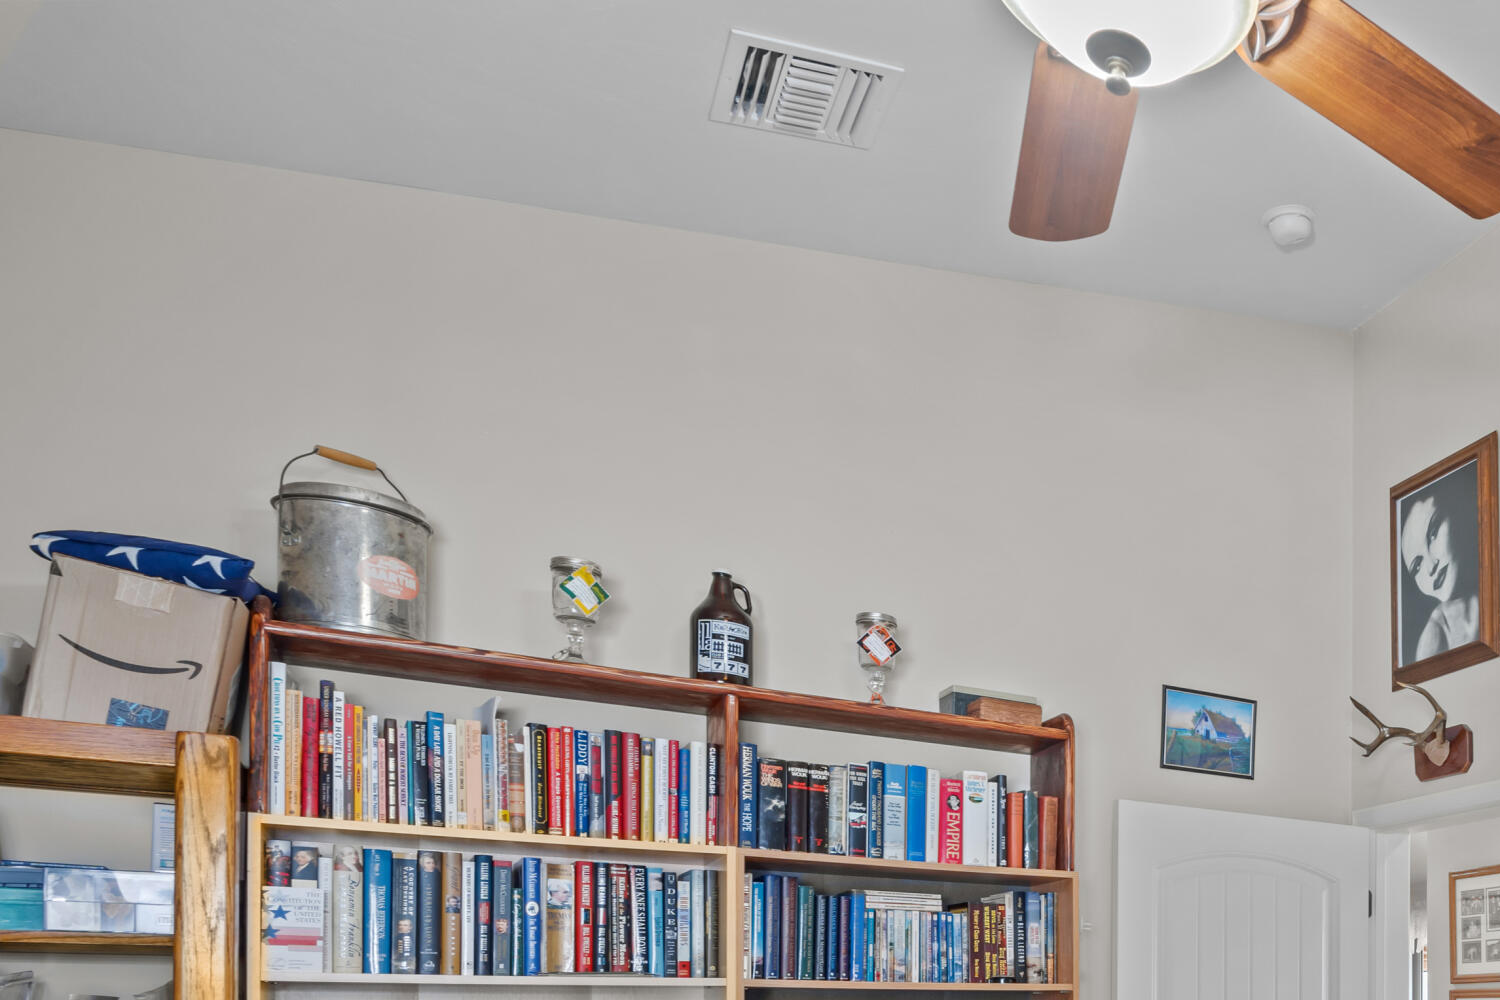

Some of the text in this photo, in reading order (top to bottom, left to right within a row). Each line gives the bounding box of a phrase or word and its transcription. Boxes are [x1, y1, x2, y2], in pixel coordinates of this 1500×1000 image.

[578, 732, 587, 765] LIDDY
[743, 746, 752, 832] HERMAN WOUK HOPE
[946, 812, 960, 859] EMPIRE
[480, 862, 489, 900] KILLING LINCOLN
[582, 865, 590, 884] KILLING
[598, 867, 606, 886] KILLING
[266, 896, 321, 905] CONSTITUTION
[377, 885, 386, 939] THOMAS JEFFERSON
[582, 885, 590, 906] KENNEDY
[598, 886, 606, 905] REAGAN
[636, 868, 645, 954] EVERY KNEE SHALL BOW
[347, 878, 361, 958] Benjamin Franklin
[424, 887, 433, 944] AMERICAN LION
[582, 927, 590, 937] BILL
[598, 928, 606, 937] BILL
[619, 876, 627, 966] Killers Flower Moon
